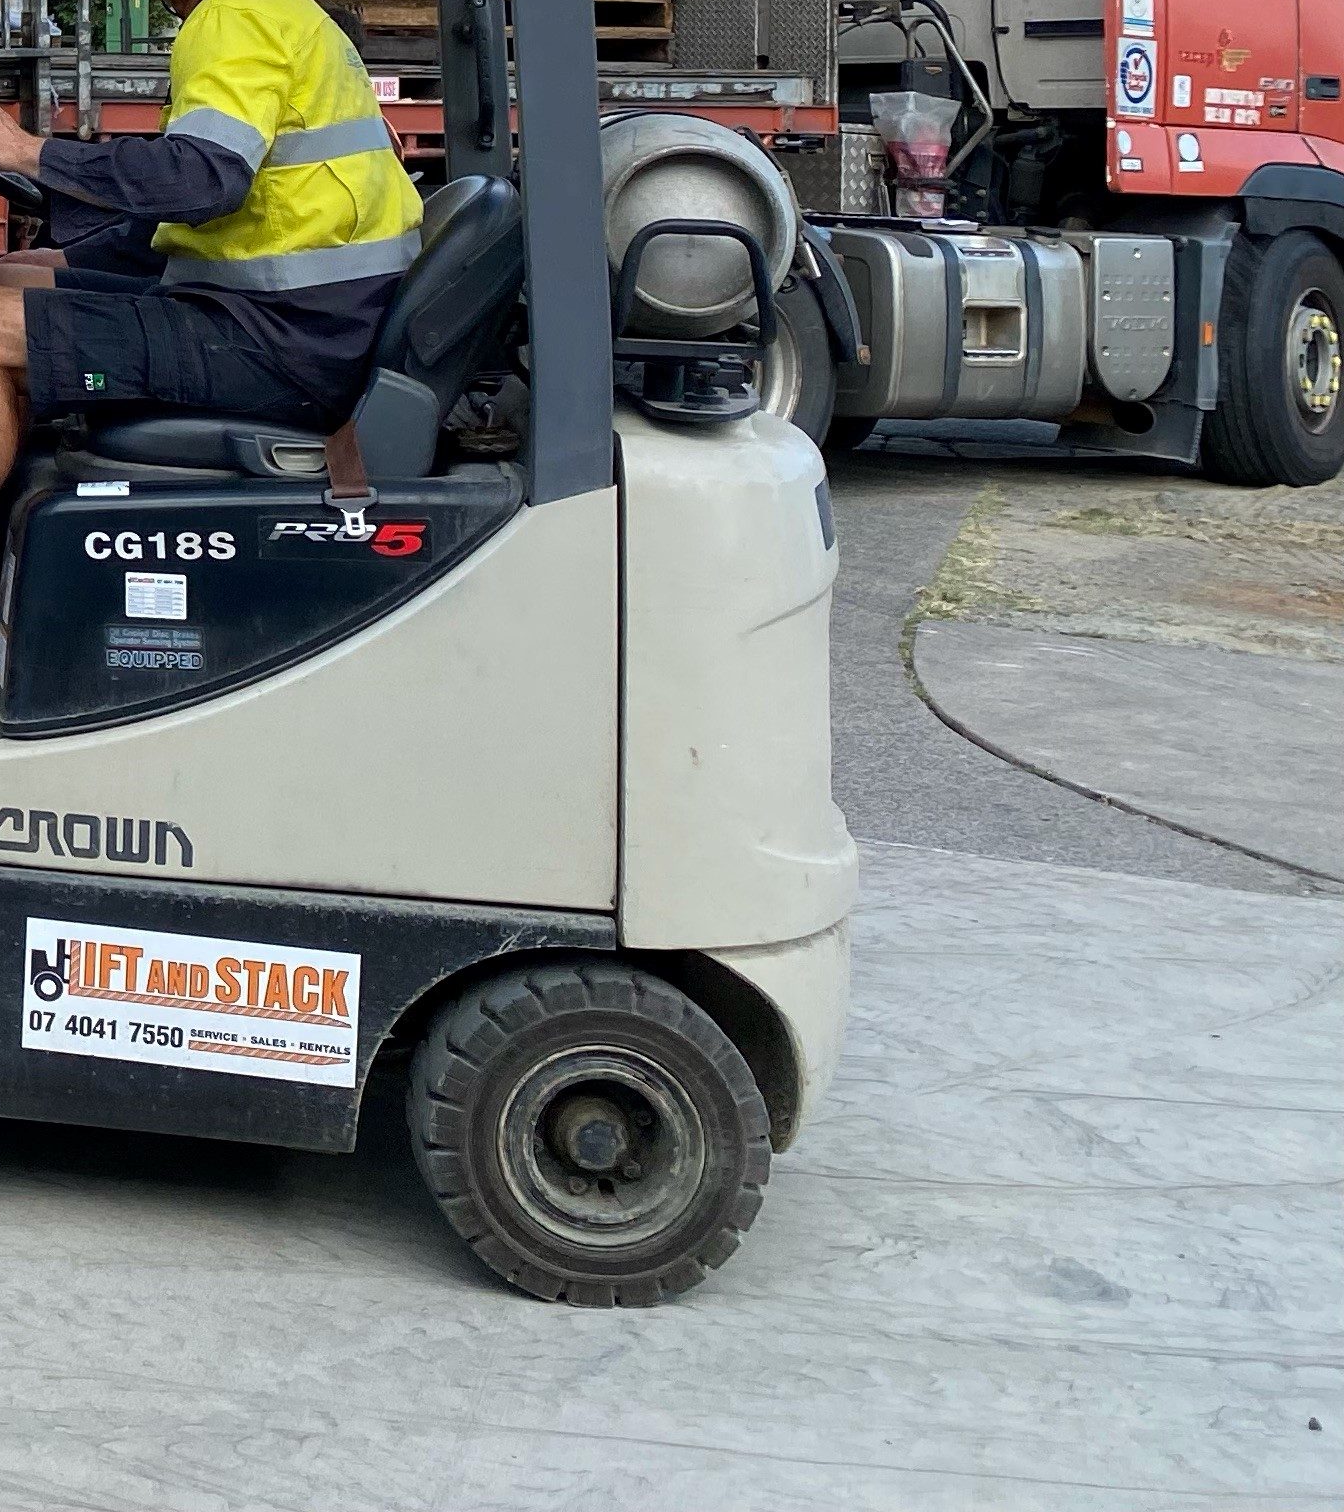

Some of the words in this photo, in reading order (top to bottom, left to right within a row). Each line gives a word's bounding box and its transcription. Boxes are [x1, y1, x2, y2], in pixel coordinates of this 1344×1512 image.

[84, 531, 237, 560] CG18S
[106, 650, 204, 669] EQUIPPED
[146, 959, 210, 999] AND
[214, 956, 351, 1018] STACK
[28, 1009, 56, 1033] 07
[63, 1013, 118, 1041] 4041
[128, 1021, 184, 1050] 7550
[190, 1028, 239, 1043] SERVICE
[250, 1035, 288, 1049] SALES
[299, 1042, 352, 1057] RENTALS
